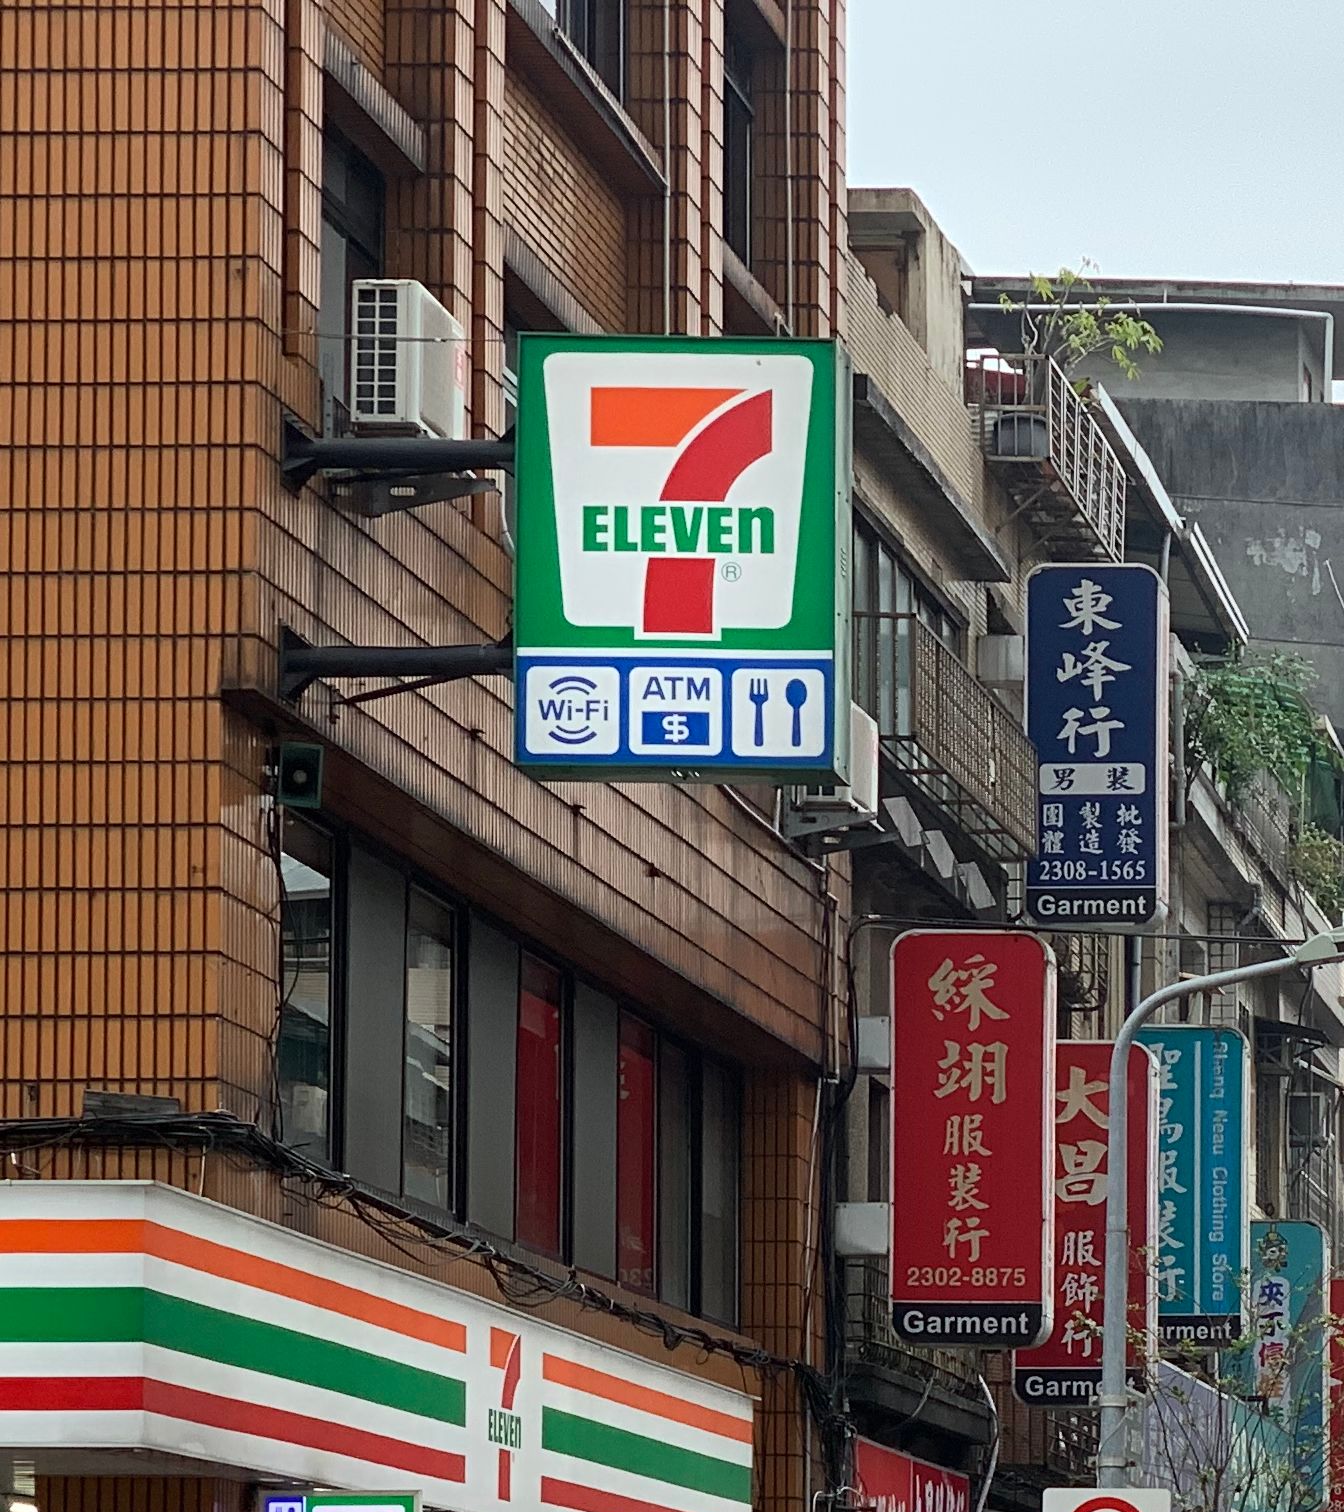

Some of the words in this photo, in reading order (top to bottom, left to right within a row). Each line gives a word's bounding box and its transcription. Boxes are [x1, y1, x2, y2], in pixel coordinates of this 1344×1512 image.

[590, 386, 773, 633] 7
[1056, 578, 1132, 758] 東峰行
[642, 676, 711, 701] ATM
[537, 699, 609, 721] Wi-Fi
[1039, 860, 1147, 881] 2308-1565
[1036, 893, 1147, 917] Garment
[1208, 1166, 1229, 1243] Clothing
[906, 1266, 1027, 1288] 2302-8875
[1211, 1253, 1229, 1302] Store
[902, 1310, 1030, 1336] Garment
[1025, 1374, 1136, 1397] Garmet
